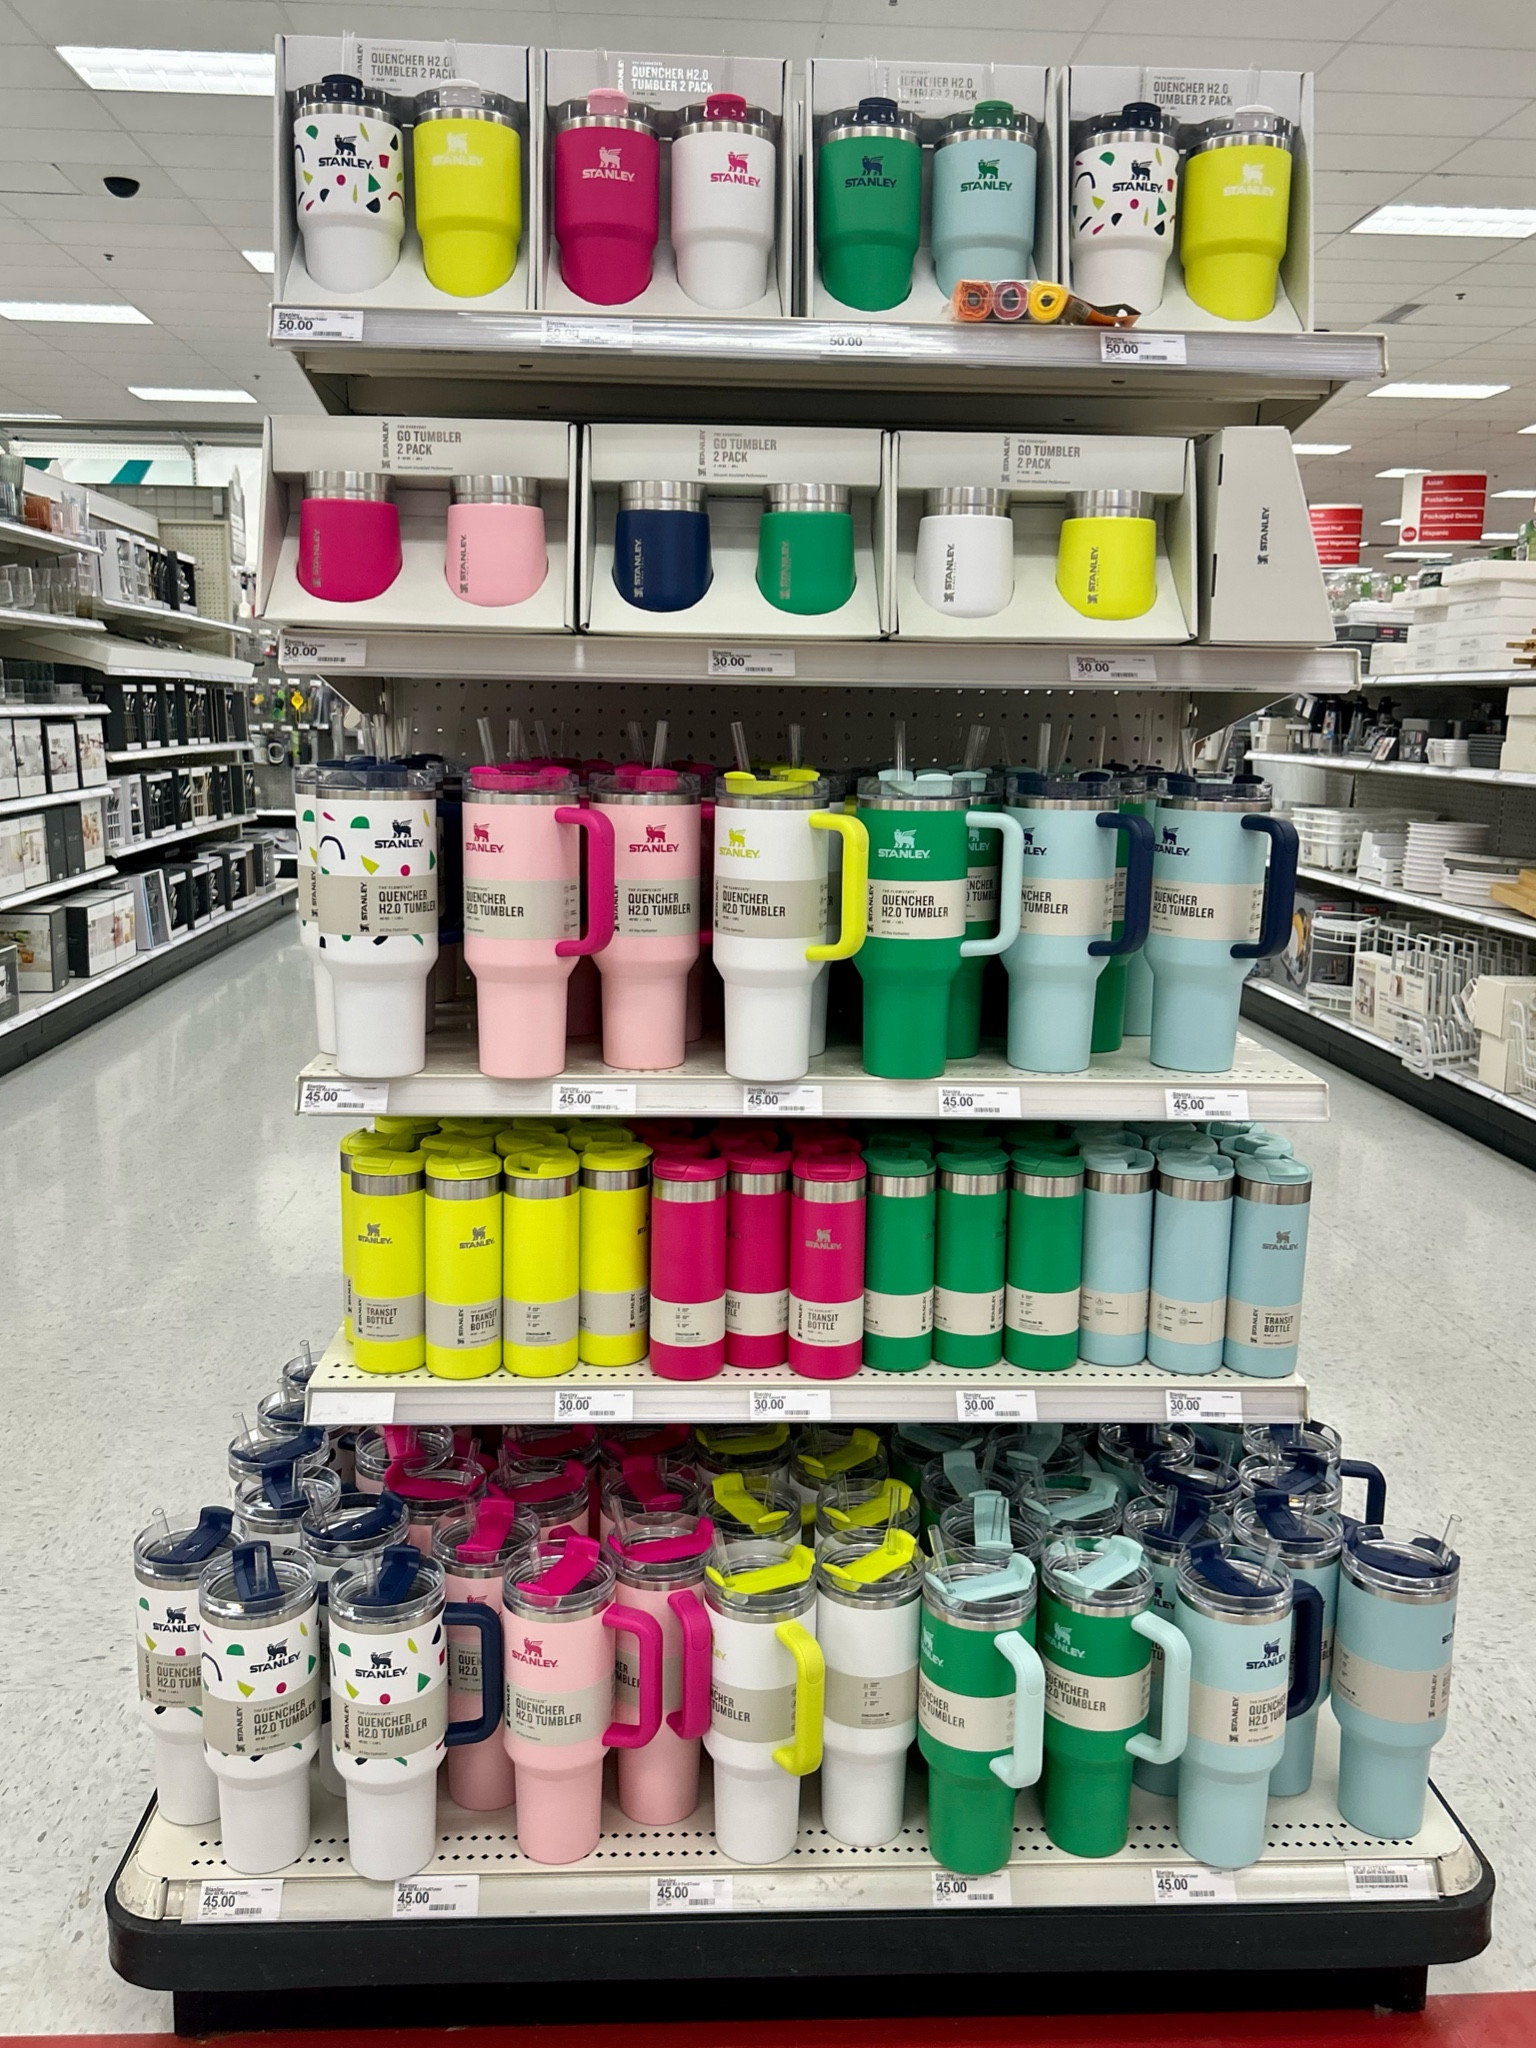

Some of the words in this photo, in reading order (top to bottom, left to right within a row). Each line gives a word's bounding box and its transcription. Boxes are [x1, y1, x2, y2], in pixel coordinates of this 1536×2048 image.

[371, 52, 425, 66] QUENCHER
[371, 64, 419, 78] TUMBLER
[420, 67, 427, 77] 2
[631, 65, 685, 80] QUENCHER
[686, 69, 709, 81] H2.0
[631, 79, 678, 92] TUMBLER
[680, 81, 687, 92] 2
[688, 81, 714, 93] PACK
[951, 77, 973, 89] H2.0
[1153, 81, 1205, 94] QUENCHER
[1206, 83, 1229, 94] H2.0
[953, 89, 978, 100] PACK
[1153, 93, 1198, 105] TUMBLER
[1200, 95, 1207, 105] 2
[1208, 95, 1233, 106] PACK
[317, 155, 374, 169] STANLEY
[431, 155, 485, 168] STANLEY
[582, 168, 635, 182] STANLEY
[709, 172, 761, 187] STANLEY
[844, 177, 897, 188] STANLEY
[960, 181, 1013, 192] STANLEY
[1112, 182, 1164, 194] STANLEY
[1223, 186, 1275, 197] STANLEY
[279, 320, 314, 331] 50.00
[829, 336, 863, 347] 50.00
[1105, 344, 1139, 354] 50.00
[397, 430, 411, 442] GO
[414, 430, 462, 443] TUMBLER
[397, 443, 404, 455] 2
[406, 443, 433, 455] PACK
[713, 438, 728, 450] GO
[730, 438, 777, 451] TUMBLER
[713, 451, 720, 462] 2
[722, 451, 748, 463] PACK
[1017, 445, 1031, 456] GO
[1034, 445, 1081, 458] TUMBLER
[1017, 457, 1024, 469] 2
[1025, 458, 1051, 469] PACK
[1259, 506, 1269, 552] STANLEY
[312, 528, 320, 576] STANLEY
[459, 534, 467, 581] STANLEY
[634, 538, 642, 586] STANLEY
[945, 543, 954, 591] STANLEY
[1089, 546, 1098, 592] STANLEY
[284, 646, 318, 657] 30.00
[712, 657, 745, 667] 30.00
[1077, 663, 1110, 673] 30.00
[373, 838, 424, 849] STANLEY
[465, 841, 504, 854] STANLEY
[628, 843, 680, 853] STANLEY
[718, 847, 760, 859] STANLEY
[877, 848, 930, 859] STANLEY
[379, 889, 428, 902] QUENCHER
[466, 890, 506, 905] QUENCHER
[628, 892, 679, 904] QUENCHER
[722, 890, 769, 905] QUENCHER
[882, 894, 935, 906] QUENCHER
[1022, 889, 1052, 902] NCHER
[1154, 890, 1198, 906] QUENCHER
[379, 903, 401, 915] H2.0
[404, 900, 436, 914] TUMBLER
[480, 905, 524, 918] TUMBLER
[628, 905, 649, 916] H2.0
[652, 903, 691, 916] TUMBLER
[722, 903, 738, 915] H2.0
[740, 905, 786, 917] TUMBLER
[881, 906, 902, 918] H2.0
[905, 906, 949, 918] TUMBLER
[1024, 901, 1069, 914] TUMBLER
[1169, 904, 1215, 919] TUMBLER
[305, 1091, 338, 1102] 45.00
[560, 1093, 591, 1104] 45.00
[748, 1095, 779, 1105] 45.00
[943, 1096, 974, 1107] 45.00
[1173, 1099, 1204, 1110] 45.00
[357, 1235, 393, 1244] STANLEY
[459, 1239, 495, 1250] STANLEY
[805, 1241, 842, 1250] STANLEY
[1262, 1243, 1298, 1251] STANLEY
[366, 1307, 398, 1316] TRANSIT
[470, 1308, 498, 1322] TRANSIT
[807, 1312, 839, 1322] TRANSIT
[366, 1316, 394, 1325] BOTTLE
[470, 1318, 496, 1331] BOTTLE
[807, 1321, 835, 1331] BOTTLE
[1264, 1315, 1294, 1325] TRANSIT
[1264, 1323, 1291, 1333] BOTTLE
[559, 1399, 590, 1411] 30.00
[754, 1399, 784, 1410] 30.00
[964, 1399, 994, 1411] 30.00
[1170, 1399, 1200, 1411] 30.00
[152, 1622, 201, 1633] STANLEY
[249, 1652, 301, 1674] STANLEY
[511, 1649, 559, 1668] STANLEY
[1245, 1652, 1287, 1670] STANLEY
[156, 1665, 202, 1678] QUENCHE
[355, 1666, 408, 1679] STANLEY
[458, 1665, 478, 1677] H2.0
[157, 1678, 176, 1688] H2.0
[515, 1697, 565, 1716] QUENCHER
[1061, 1692, 1107, 1712] TUMBLER
[254, 1698, 306, 1724] QUENCHER
[712, 1699, 751, 1723] TUMBLER
[927, 1701, 965, 1728] TUMBLER
[1231, 1696, 1239, 1732] STANLEY
[254, 1724, 277, 1736] H2.0
[280, 1701, 317, 1730] TUMBLER
[357, 1712, 412, 1727] QUENCHER
[515, 1711, 533, 1725] H2.0
[535, 1713, 582, 1727] TUMBLER
[1248, 1714, 1268, 1727] H2.0
[357, 1727, 378, 1739] H2.0
[380, 1717, 428, 1738] TUMBLER
[936, 1881, 967, 1893] 45.00
[1157, 1878, 1188, 1890] 45.00
[397, 1891, 430, 1904] 45.00
[657, 1886, 689, 1899] 45.00
[203, 1895, 236, 1908] 45.00
